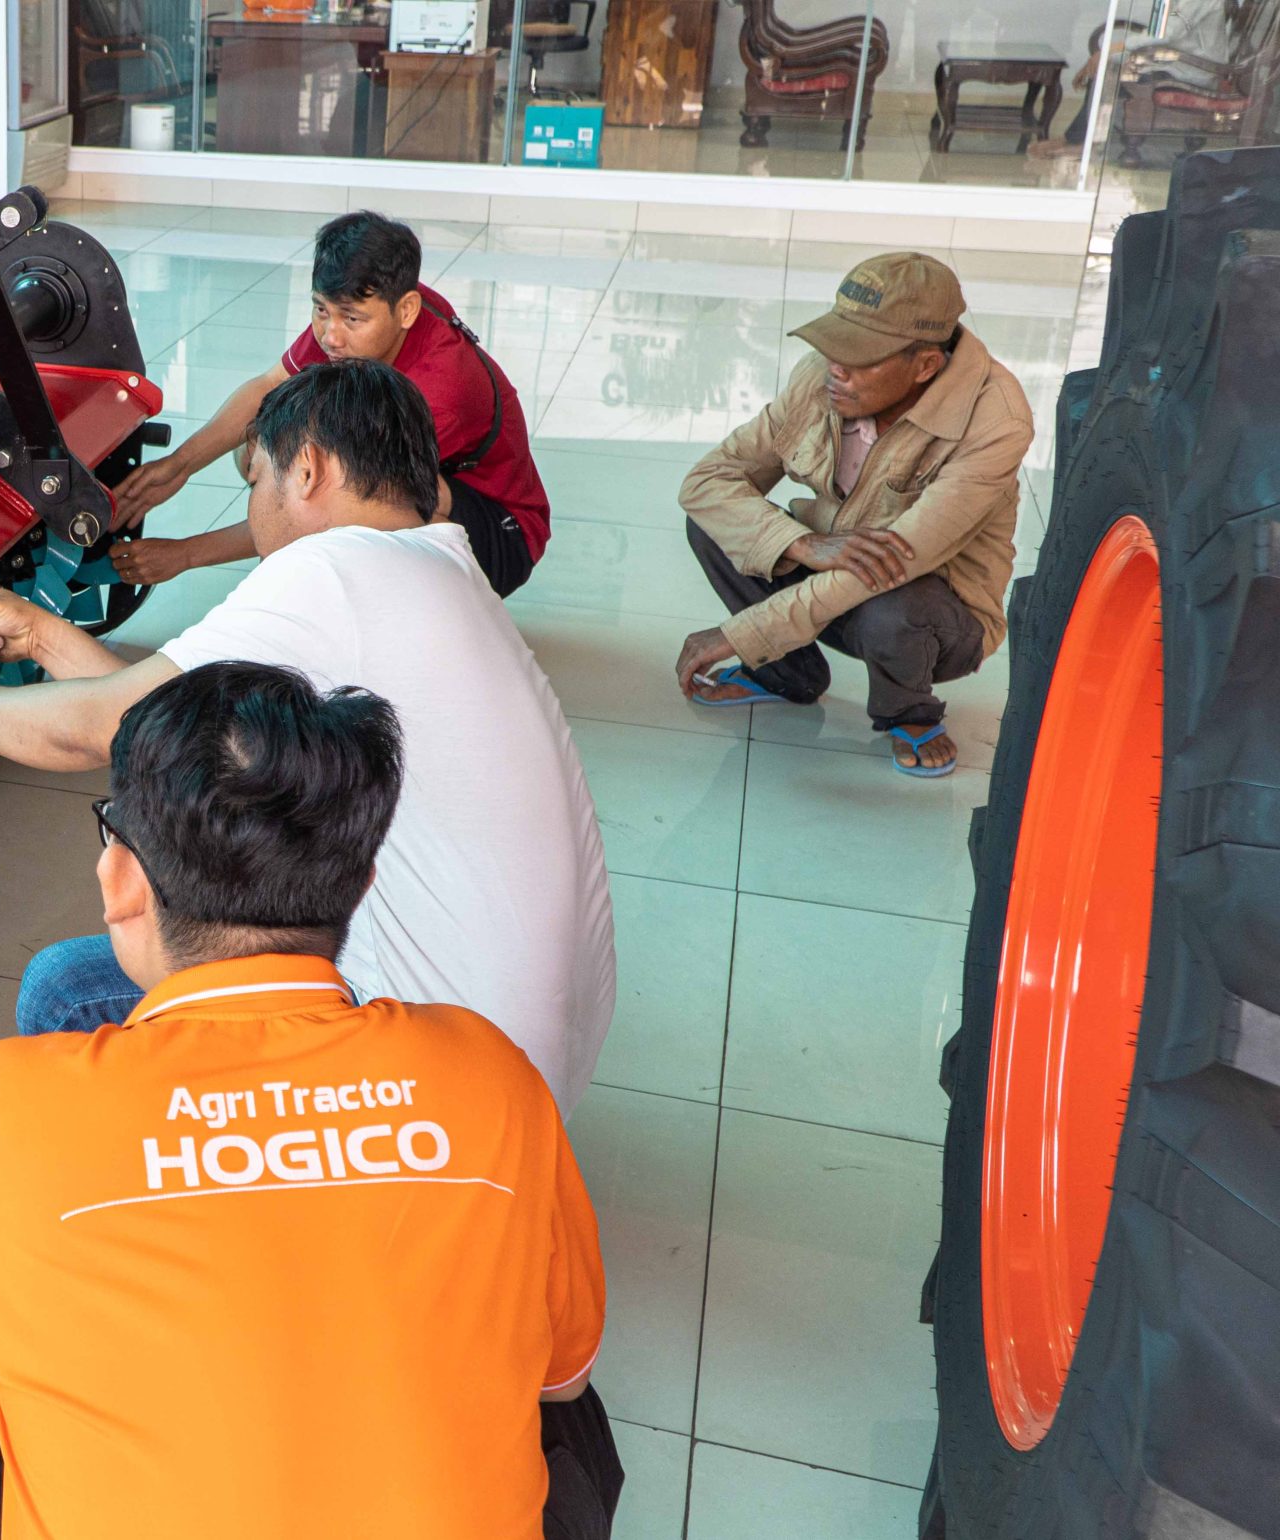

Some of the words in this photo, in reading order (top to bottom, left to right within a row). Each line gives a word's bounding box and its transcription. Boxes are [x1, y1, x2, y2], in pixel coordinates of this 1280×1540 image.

[166, 1087, 256, 1128] Agri
[263, 1078, 417, 1117] Tractor
[142, 1120, 451, 1190] HOGICO
